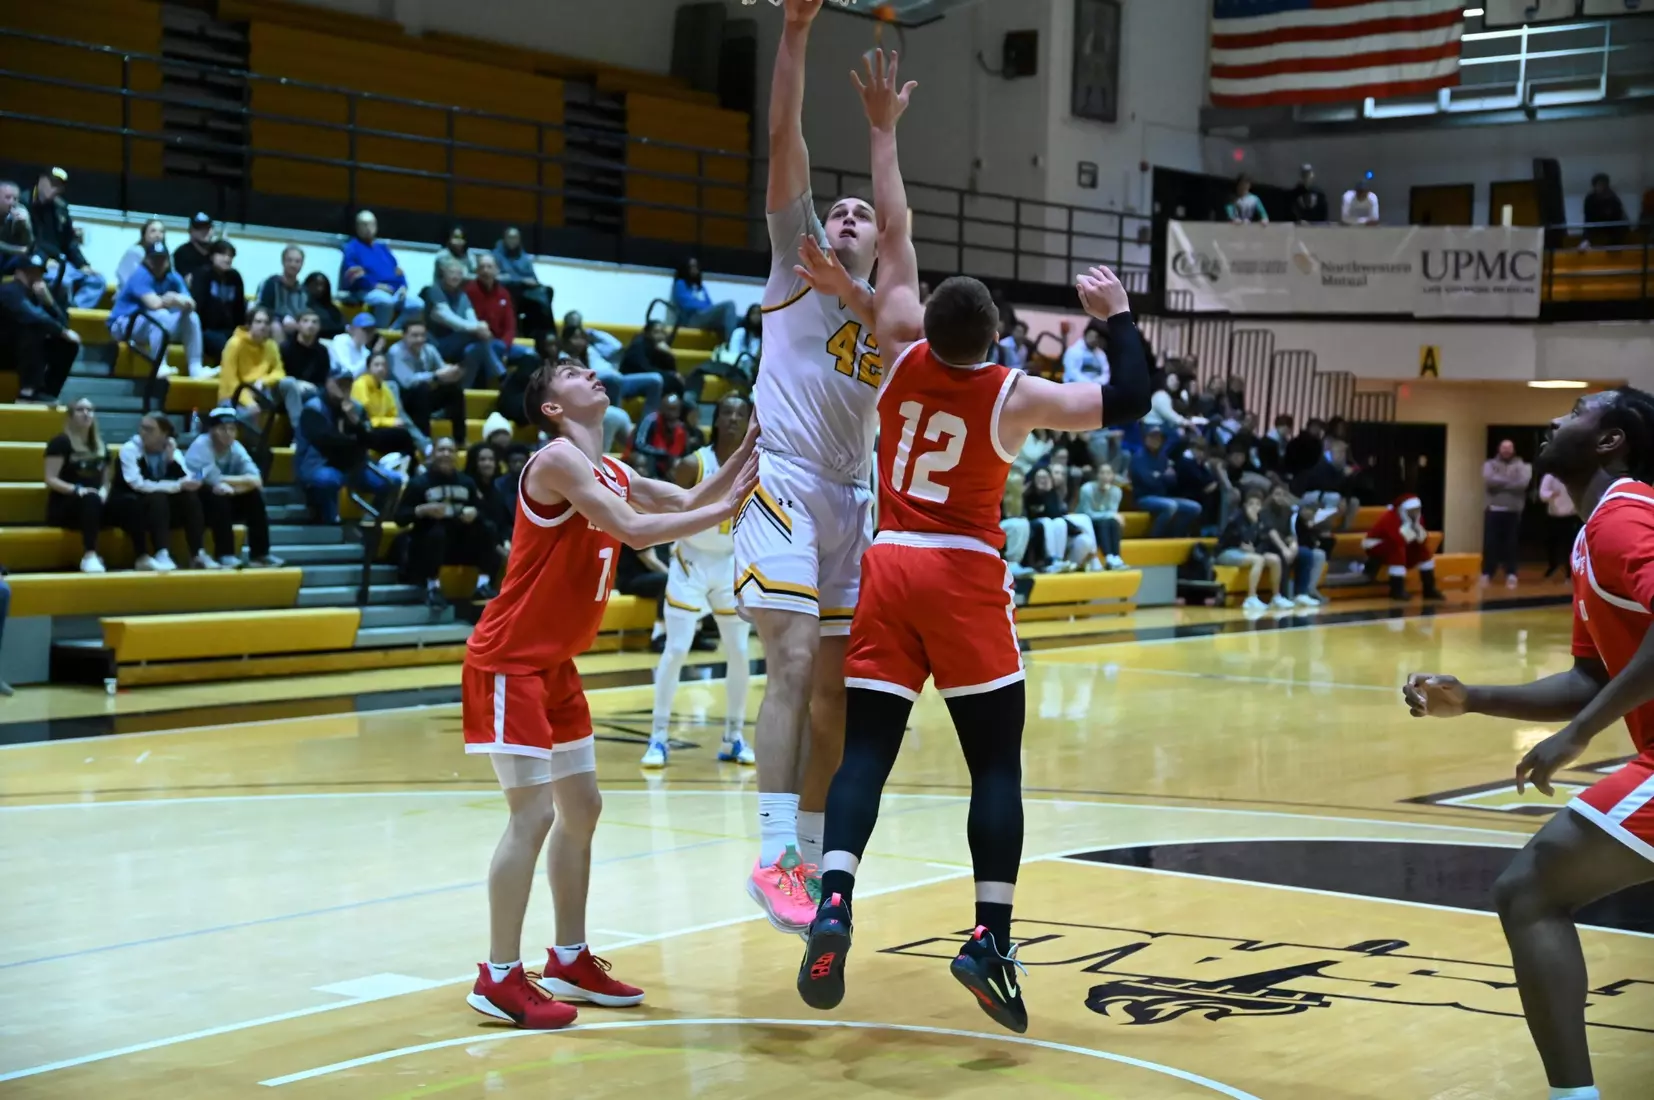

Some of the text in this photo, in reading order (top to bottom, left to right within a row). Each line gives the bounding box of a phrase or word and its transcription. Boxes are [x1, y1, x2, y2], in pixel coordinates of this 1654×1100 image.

[1421, 250, 1538, 282] UPMC
[826, 319, 883, 388] 42
[1420, 346, 1439, 378] A
[892, 400, 968, 504] 12
[594, 547, 614, 602] 1
